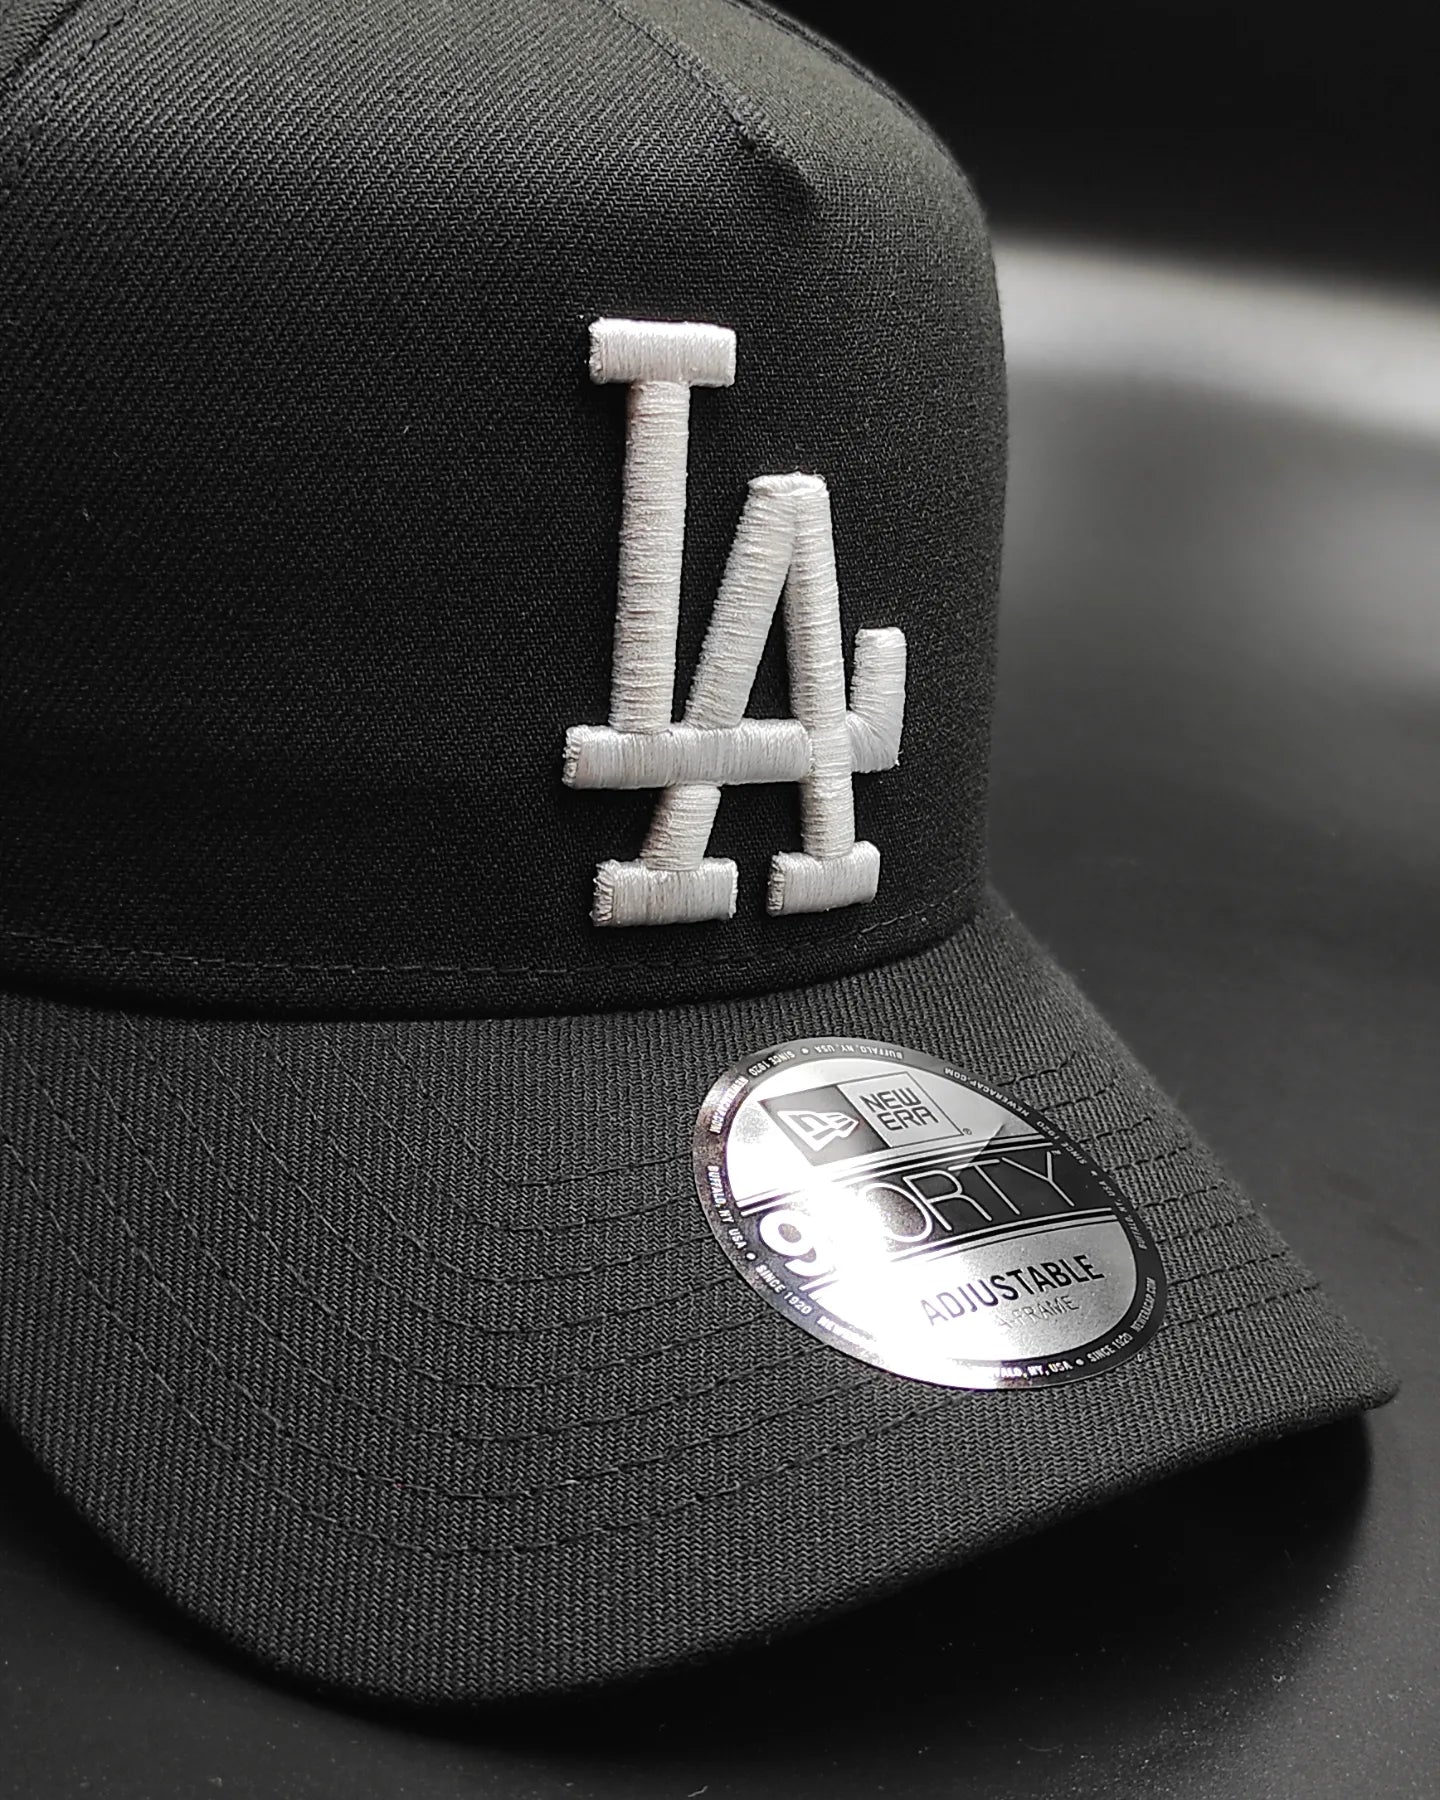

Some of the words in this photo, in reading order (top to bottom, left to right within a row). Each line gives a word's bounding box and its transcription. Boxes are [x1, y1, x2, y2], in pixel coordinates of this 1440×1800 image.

[562, 316, 907, 927] LA
[767, 1050, 796, 1066] SINCE
[813, 1043, 836, 1053] USA
[748, 1060, 771, 1076] 1920
[859, 1087, 922, 1113] NEW
[944, 1066, 1030, 1117] NEWERACAP.COM
[877, 1105, 939, 1131] ERA
[1036, 1120, 1060, 1140] 1920
[728, 1228, 748, 1249] USA
[755, 1263, 786, 1293] SINCE
[783, 1291, 813, 1315] 1920
[920, 1254, 1105, 1326] ADJUSTABLE
[1047, 1360, 1074, 1373] USA
[1086, 1344, 1116, 1362] SINCE
[1111, 1332, 1133, 1349] 1920
